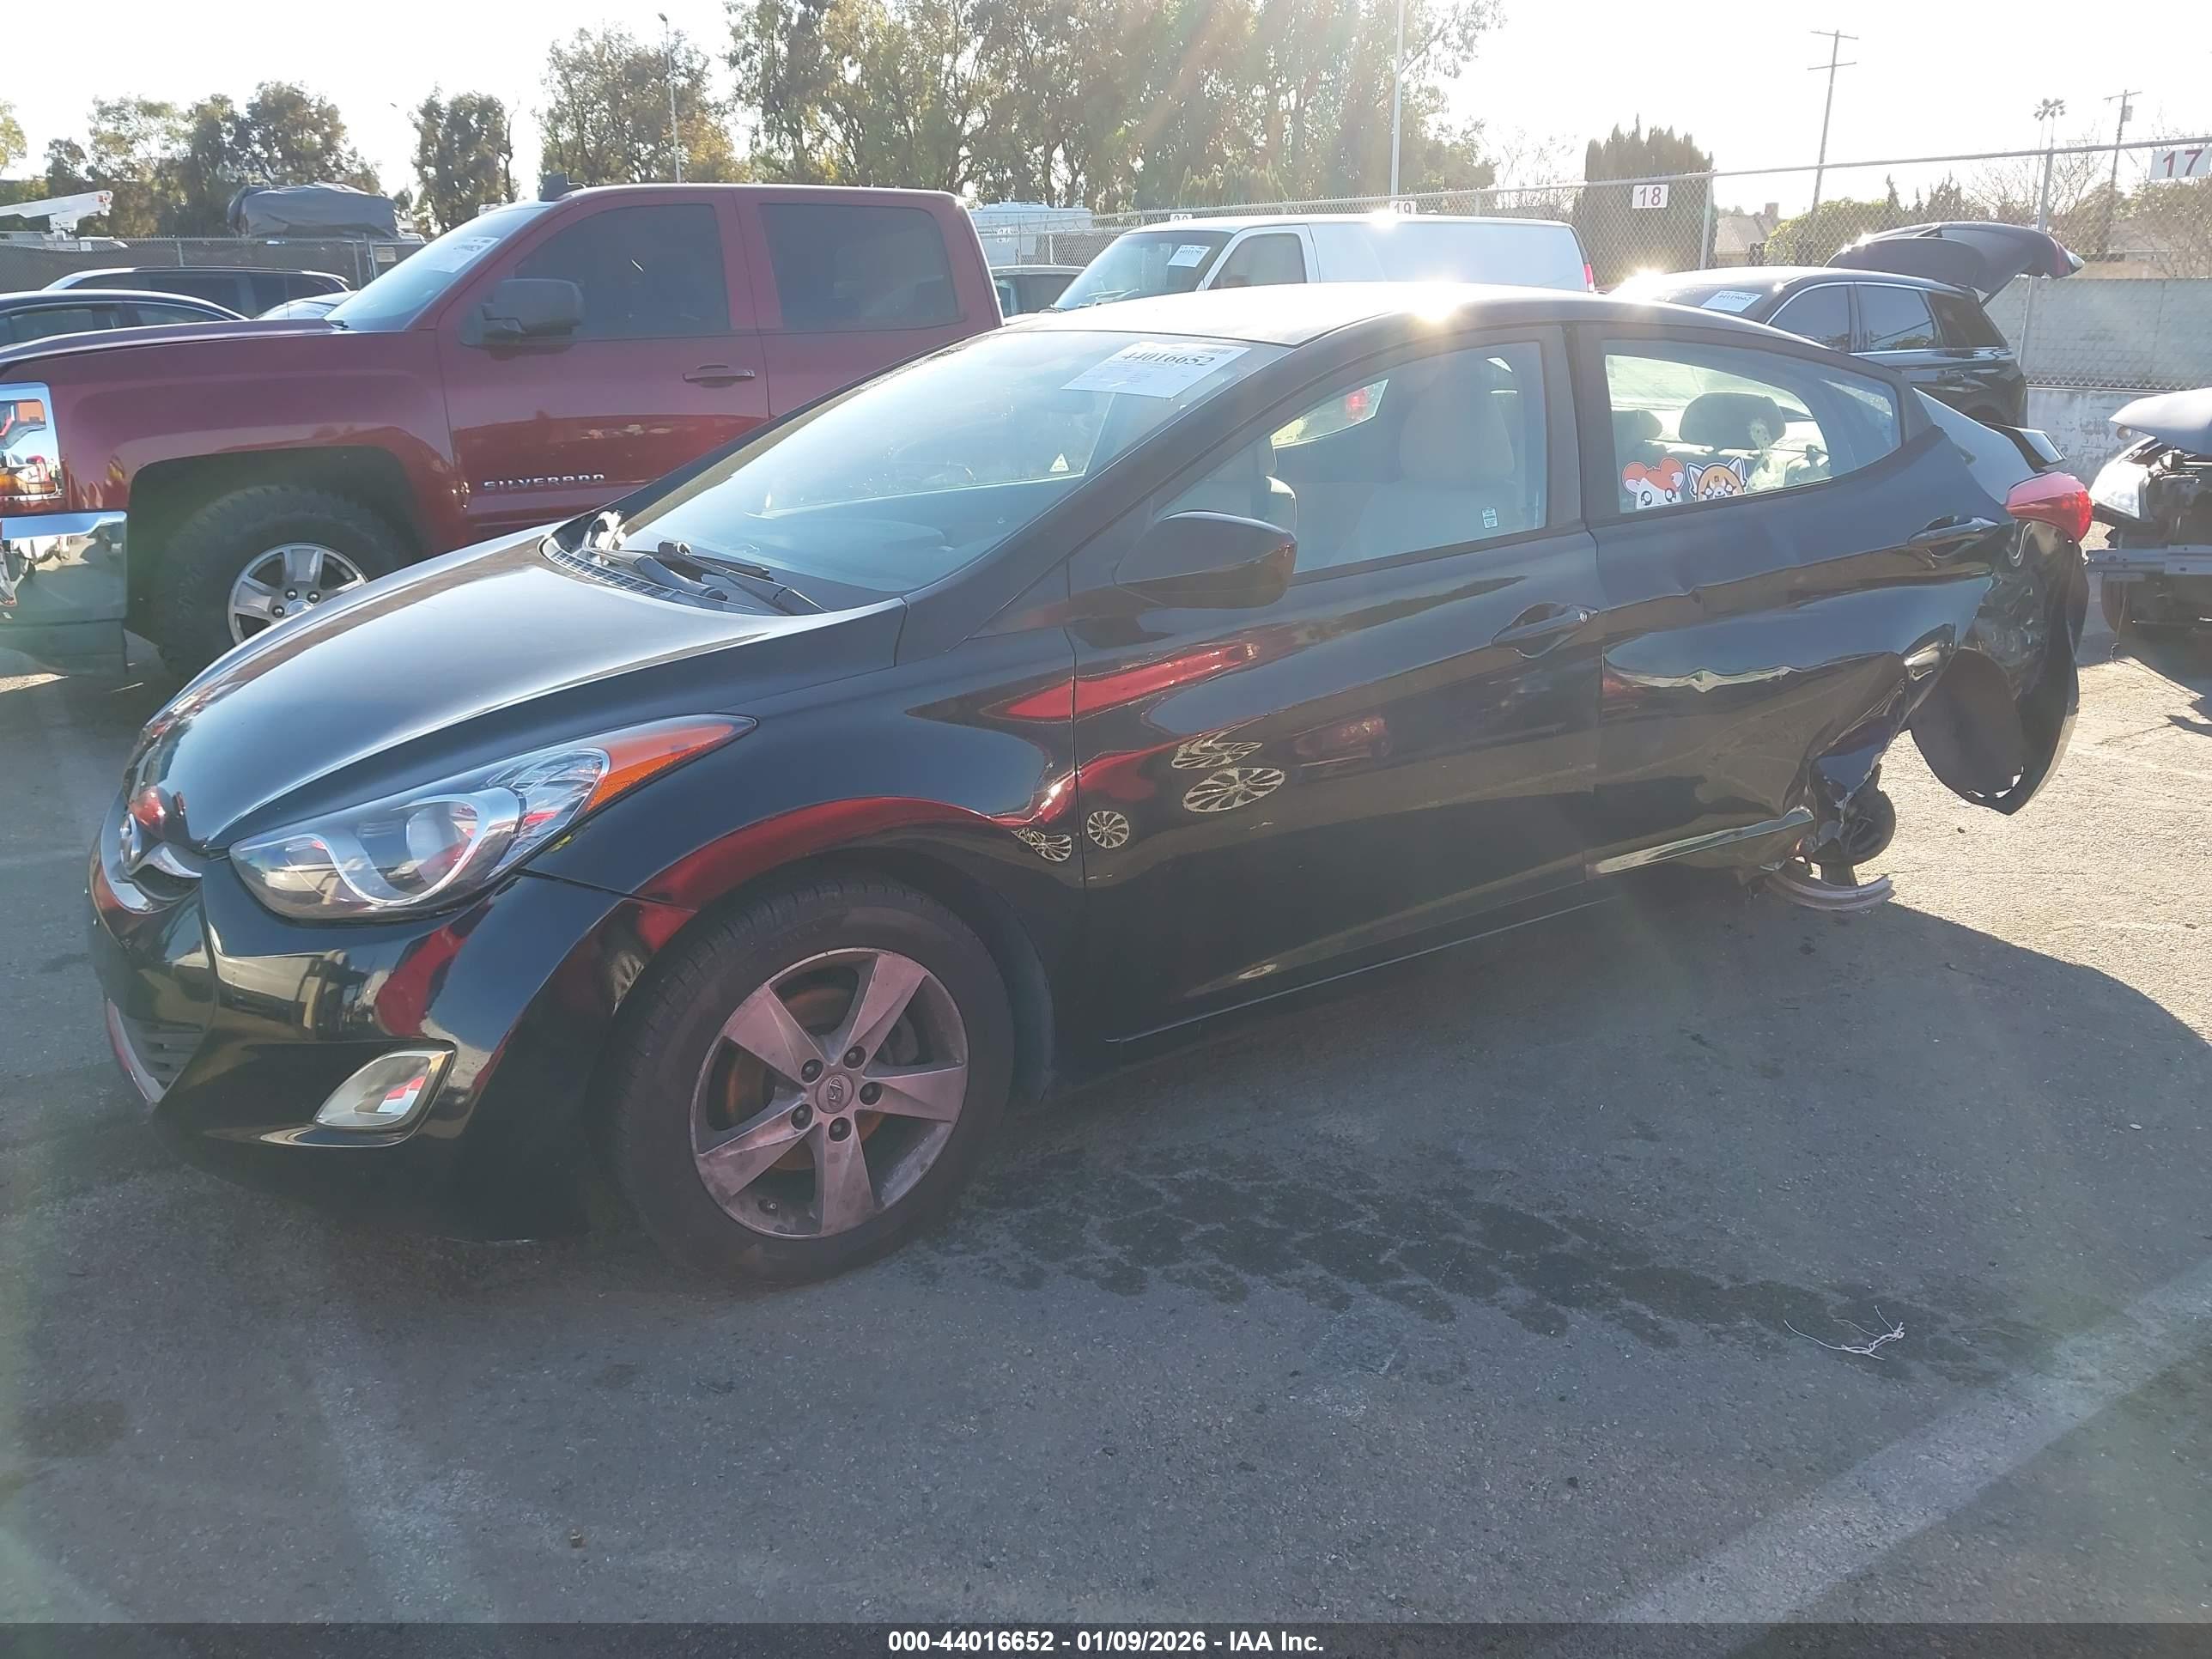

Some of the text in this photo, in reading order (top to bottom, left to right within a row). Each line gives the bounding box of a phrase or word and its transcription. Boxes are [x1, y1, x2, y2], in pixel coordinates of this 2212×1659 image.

[2162, 149, 2203, 178] 17
[1639, 185, 1662, 207] 18
[1394, 202, 1413, 215] 19
[1120, 352, 1216, 367] 44016652
[483, 472, 605, 491] SILVERADO
